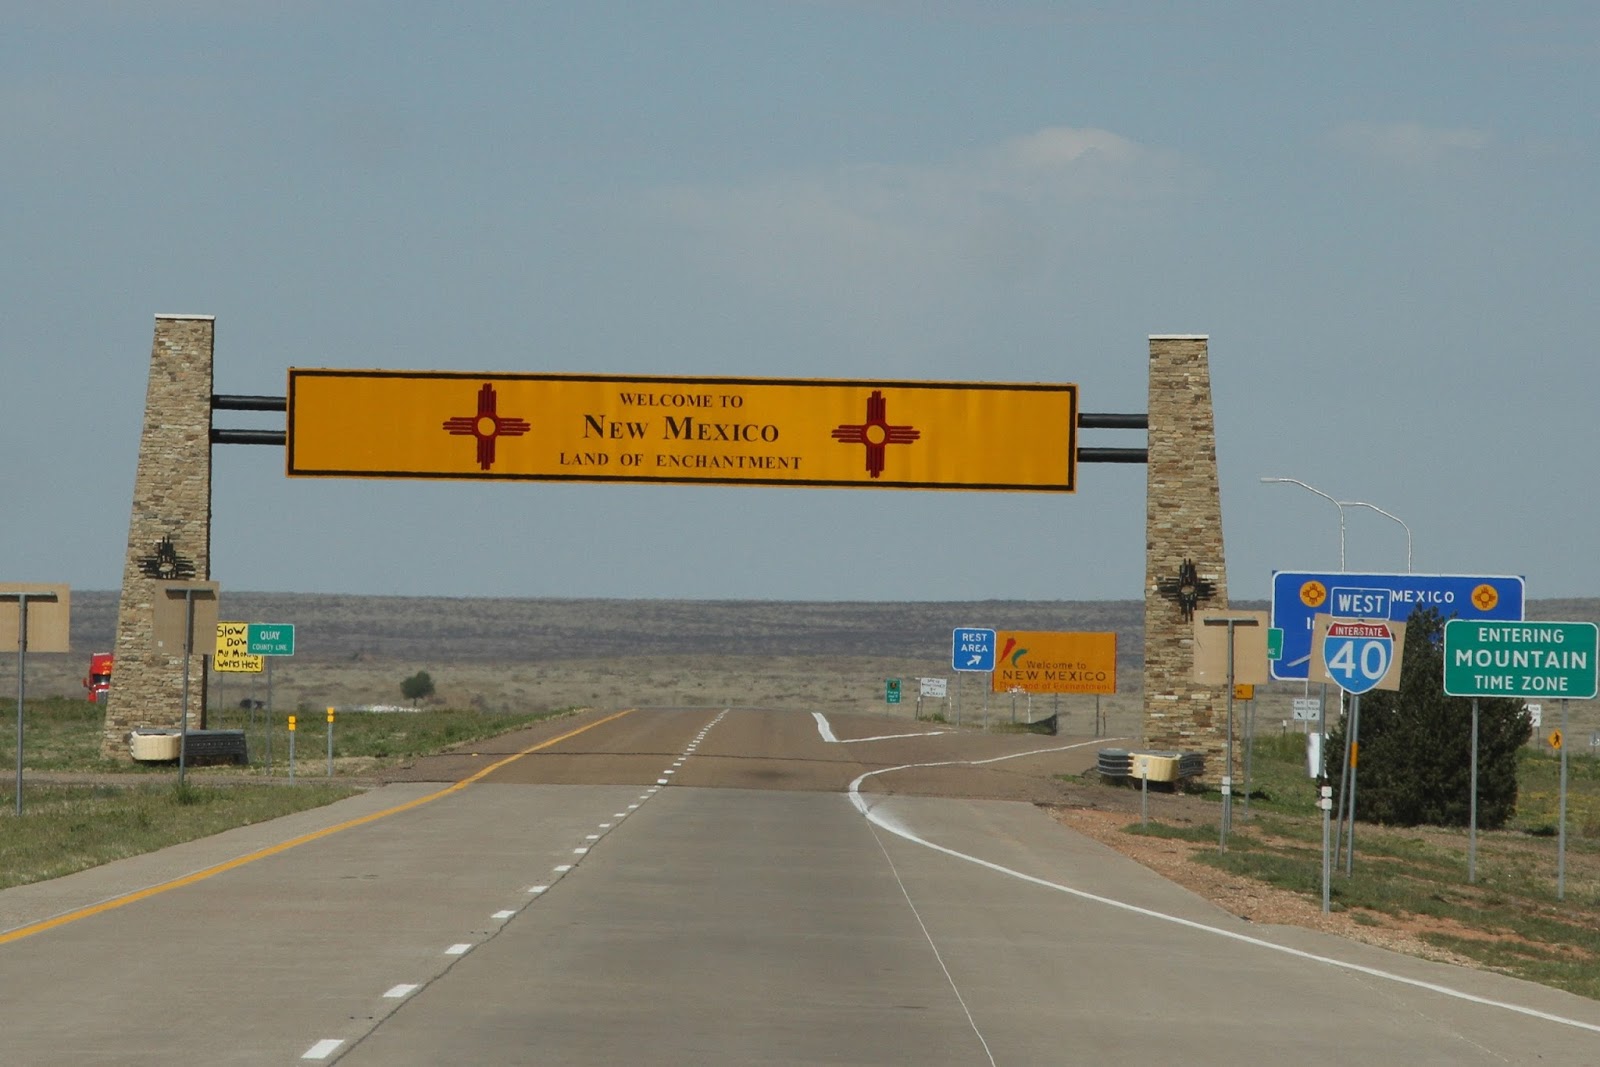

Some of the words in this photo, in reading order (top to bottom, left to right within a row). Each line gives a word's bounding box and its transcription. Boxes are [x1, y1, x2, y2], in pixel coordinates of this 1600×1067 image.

[620, 392, 713, 408] WELCOME
[719, 394, 744, 408] TO
[583, 414, 649, 440] NEW
[663, 415, 779, 443] MEXICO
[560, 452, 609, 466] LAND
[620, 453, 644, 467] OF
[656, 454, 803, 470] ENCHANTMENT
[1338, 594, 1384, 613] WEST
[1392, 590, 1455, 604] MEXICO
[260, 631, 280, 640] QUAY
[962, 632, 987, 642] REST
[1335, 626, 1383, 637] INTERSTATE
[1479, 627, 1565, 643] ENTERING
[252, 643, 274, 651] COUNTY
[961, 643, 988, 653] AREA
[1026, 660, 1073, 670] Welcome
[1077, 662, 1087, 670] to
[1328, 640, 1387, 680] 40
[1455, 649, 1587, 669] MOUNTAIN
[1002, 670, 1039, 680] NEW
[1045, 670, 1106, 682] MEXICO
[1474, 675, 1514, 690] TIME
[1522, 676, 1569, 691] ZONE
